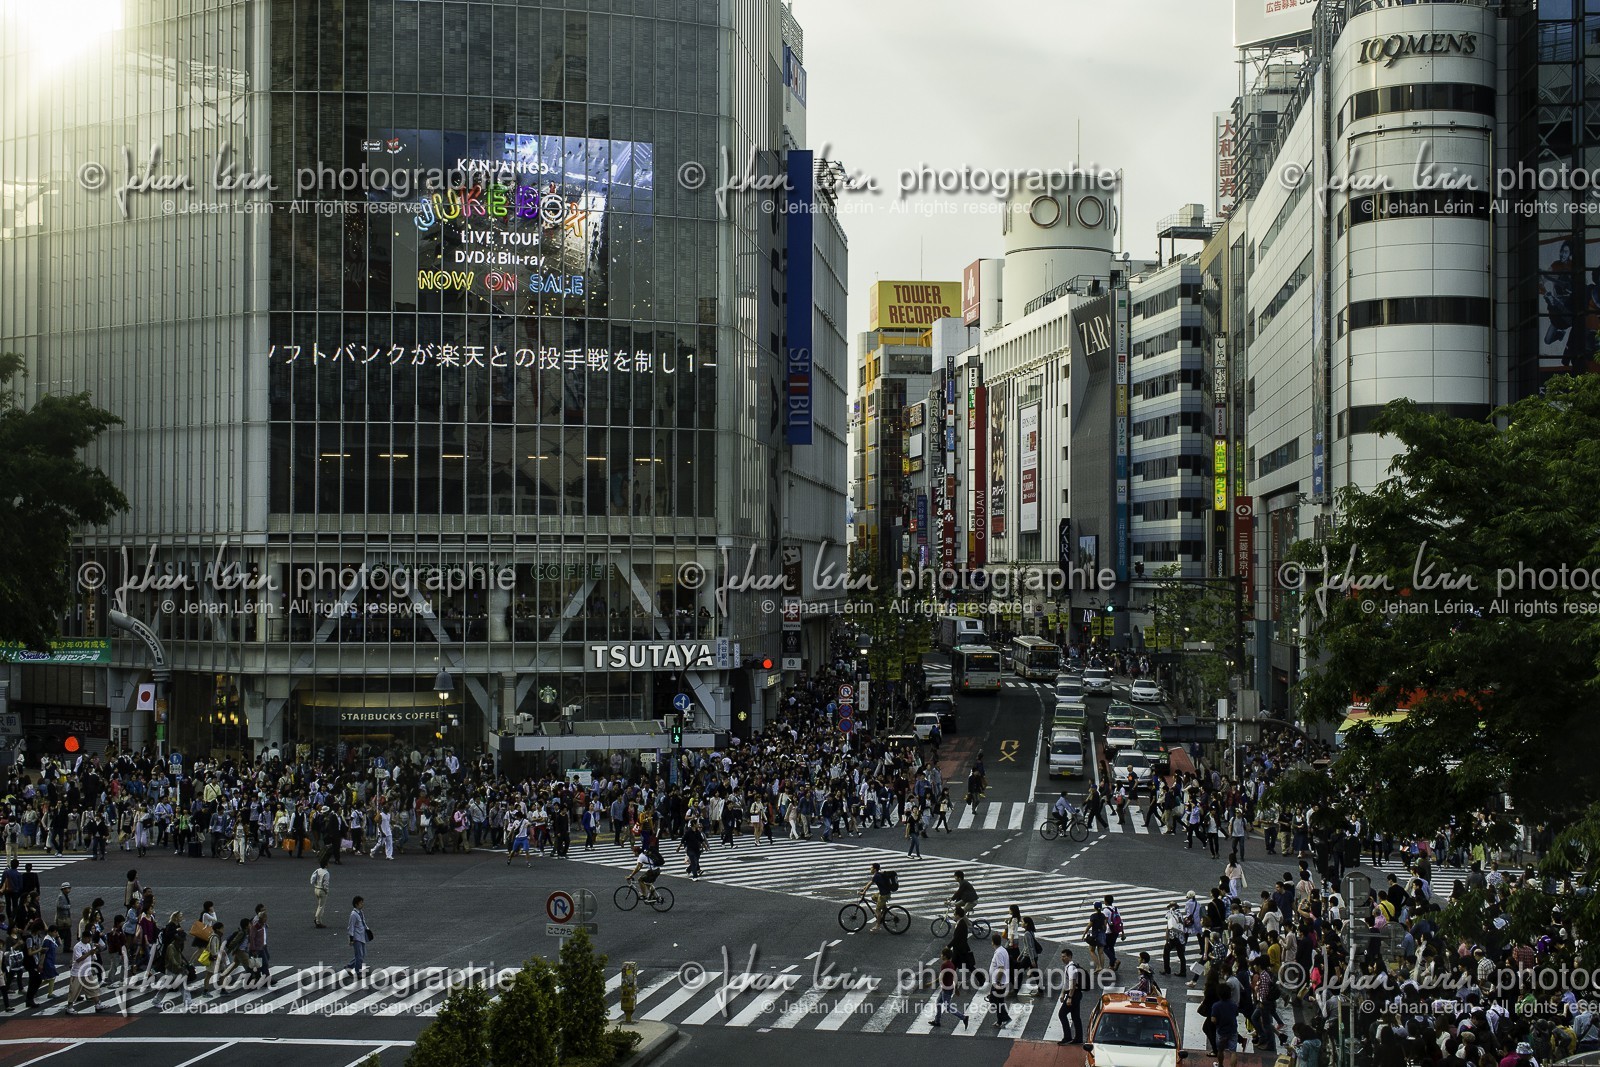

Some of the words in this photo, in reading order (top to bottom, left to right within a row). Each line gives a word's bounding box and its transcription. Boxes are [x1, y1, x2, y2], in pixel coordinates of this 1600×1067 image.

[460, 231, 495, 245] LIVE
[418, 269, 474, 290] NOW
[485, 272, 517, 291] ON
[530, 273, 584, 295] SALE
[893, 285, 942, 304] TOWER
[888, 305, 952, 325] RECORDS
[788, 347, 810, 426] SEIBU
[929, 391, 939, 451] KARAOKE
[591, 644, 714, 668] TSUTAYA
[341, 713, 403, 721] STARBUCKS
[405, 712, 440, 720] COFFEE
[547, 927, 573, 936] ここから
